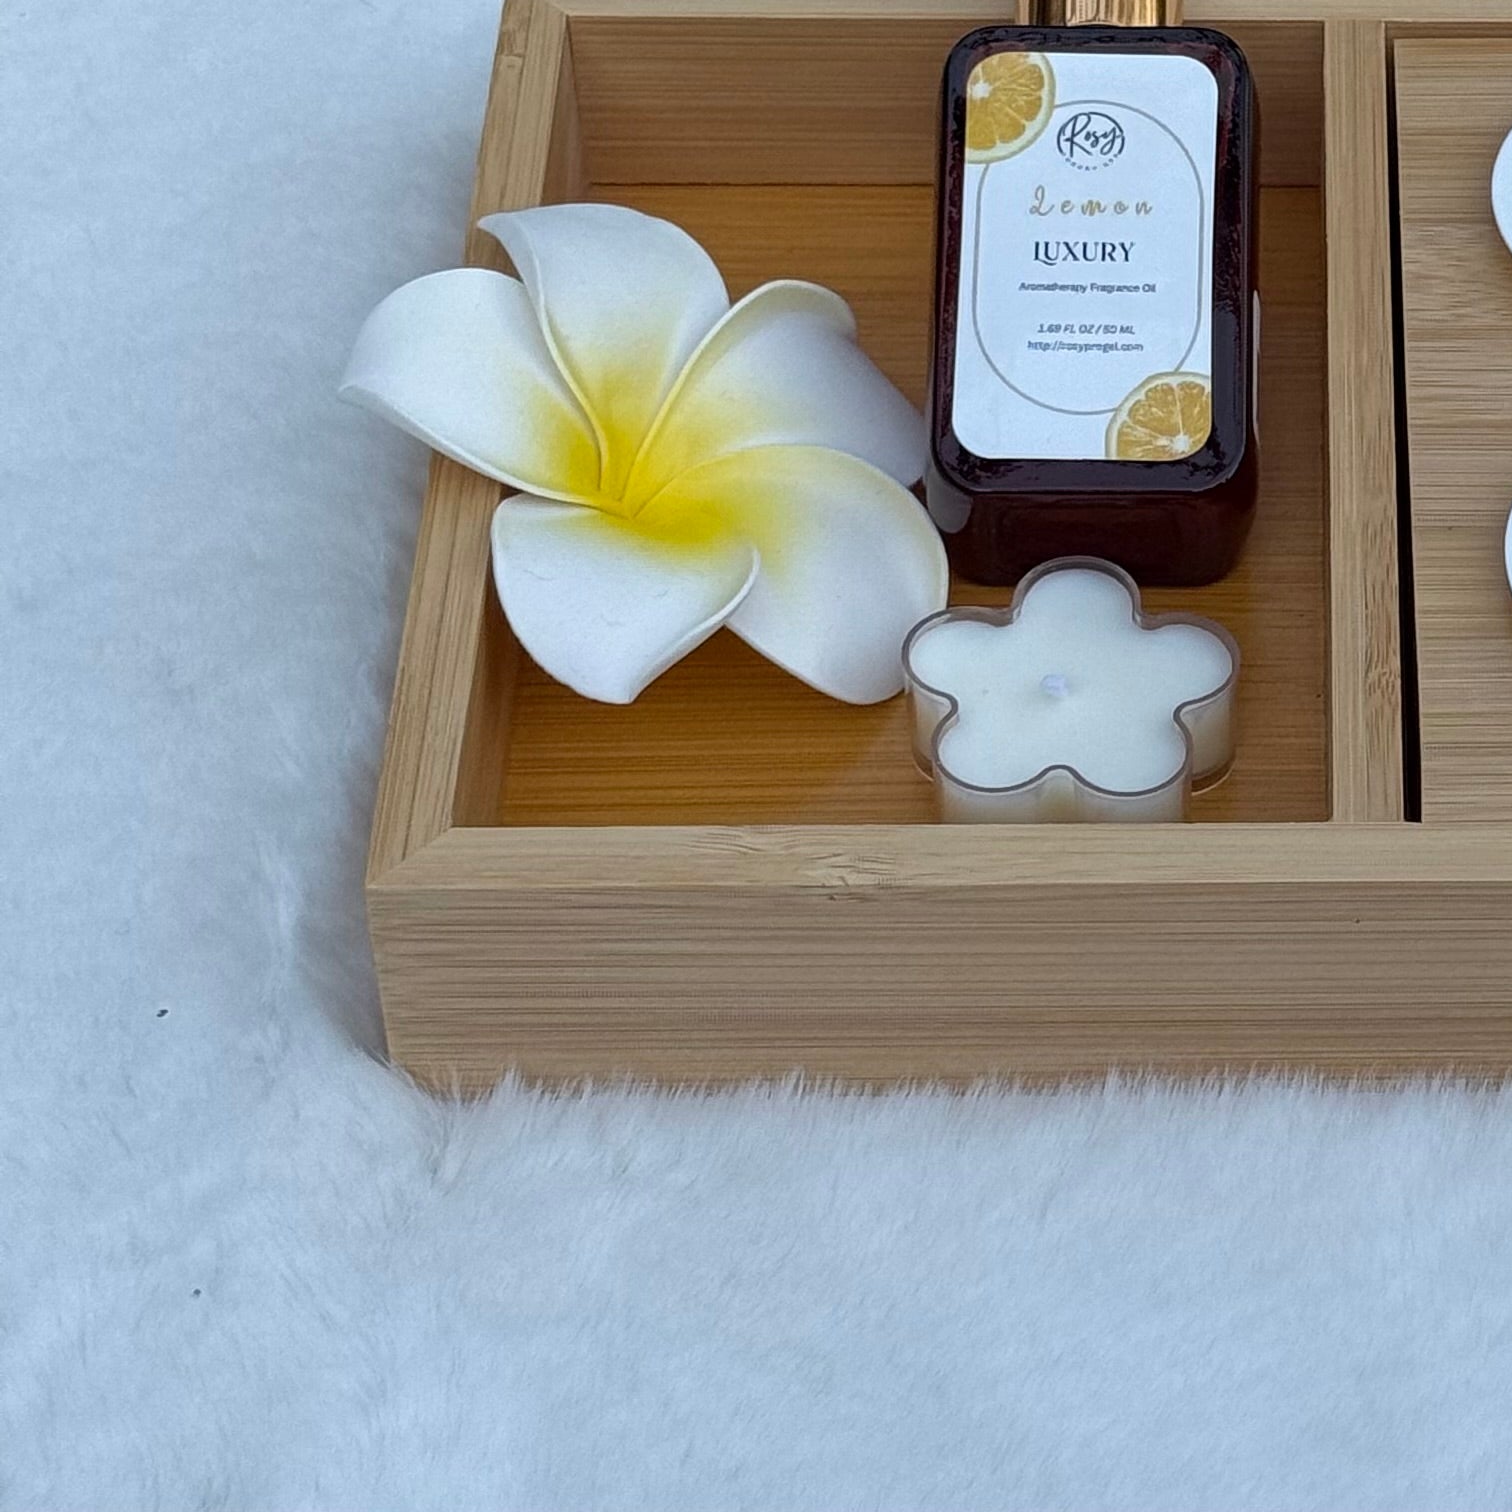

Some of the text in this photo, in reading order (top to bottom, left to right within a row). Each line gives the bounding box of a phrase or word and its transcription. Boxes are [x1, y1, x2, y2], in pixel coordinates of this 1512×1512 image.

[1029, 184, 1153, 217] Lemon
[1033, 241, 1135, 266] LUXURY
[1019, 282, 1157, 294] Aromatherapy Fragrance Oil
[1037, 323, 1062, 334] 1.69
[1062, 323, 1077, 334] FL
[1078, 324, 1094, 335] OZ
[1103, 324, 1118, 335] 50
[1119, 325, 1136, 336] ML
